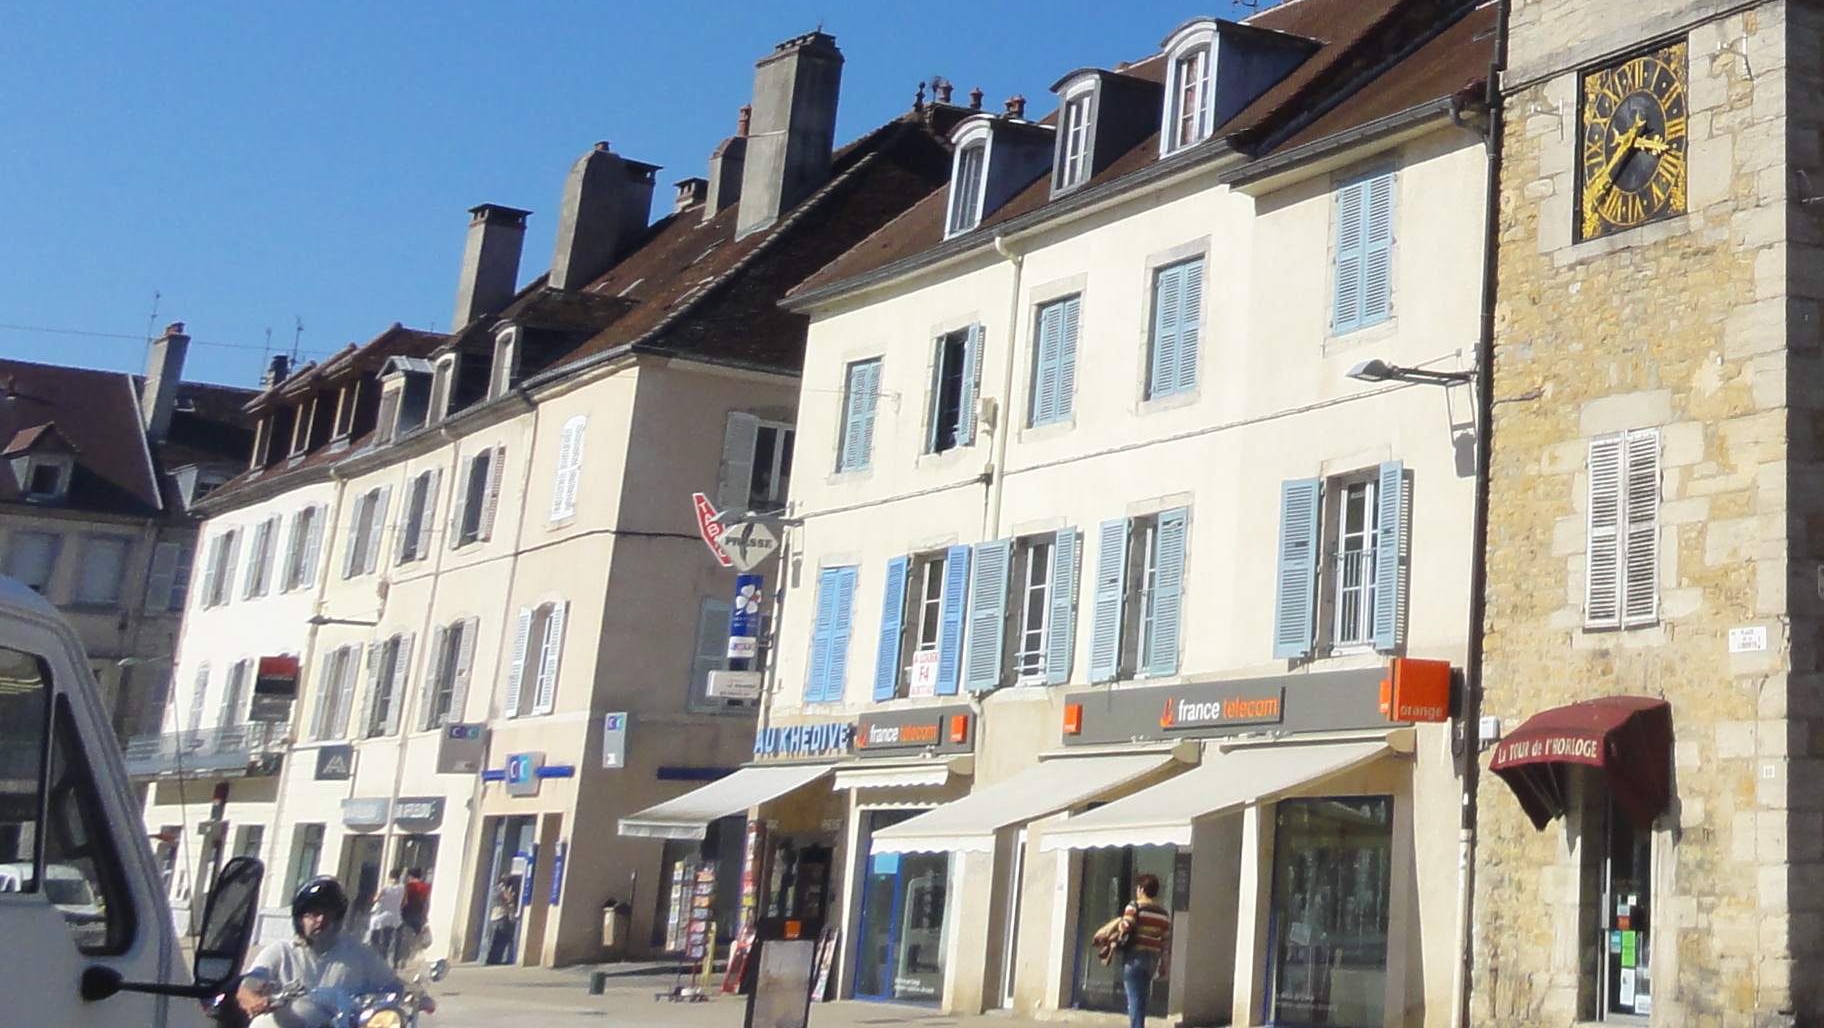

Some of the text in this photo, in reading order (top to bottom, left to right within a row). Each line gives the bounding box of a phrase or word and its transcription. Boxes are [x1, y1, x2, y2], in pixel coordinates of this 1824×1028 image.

[1178, 696, 1279, 722] france telecom
[1400, 705, 1444, 720] orange
[752, 728, 777, 754] AU
[869, 723, 900, 743] france
[1509, 740, 1530, 761] TOUR
[1531, 739, 1543, 757] de
